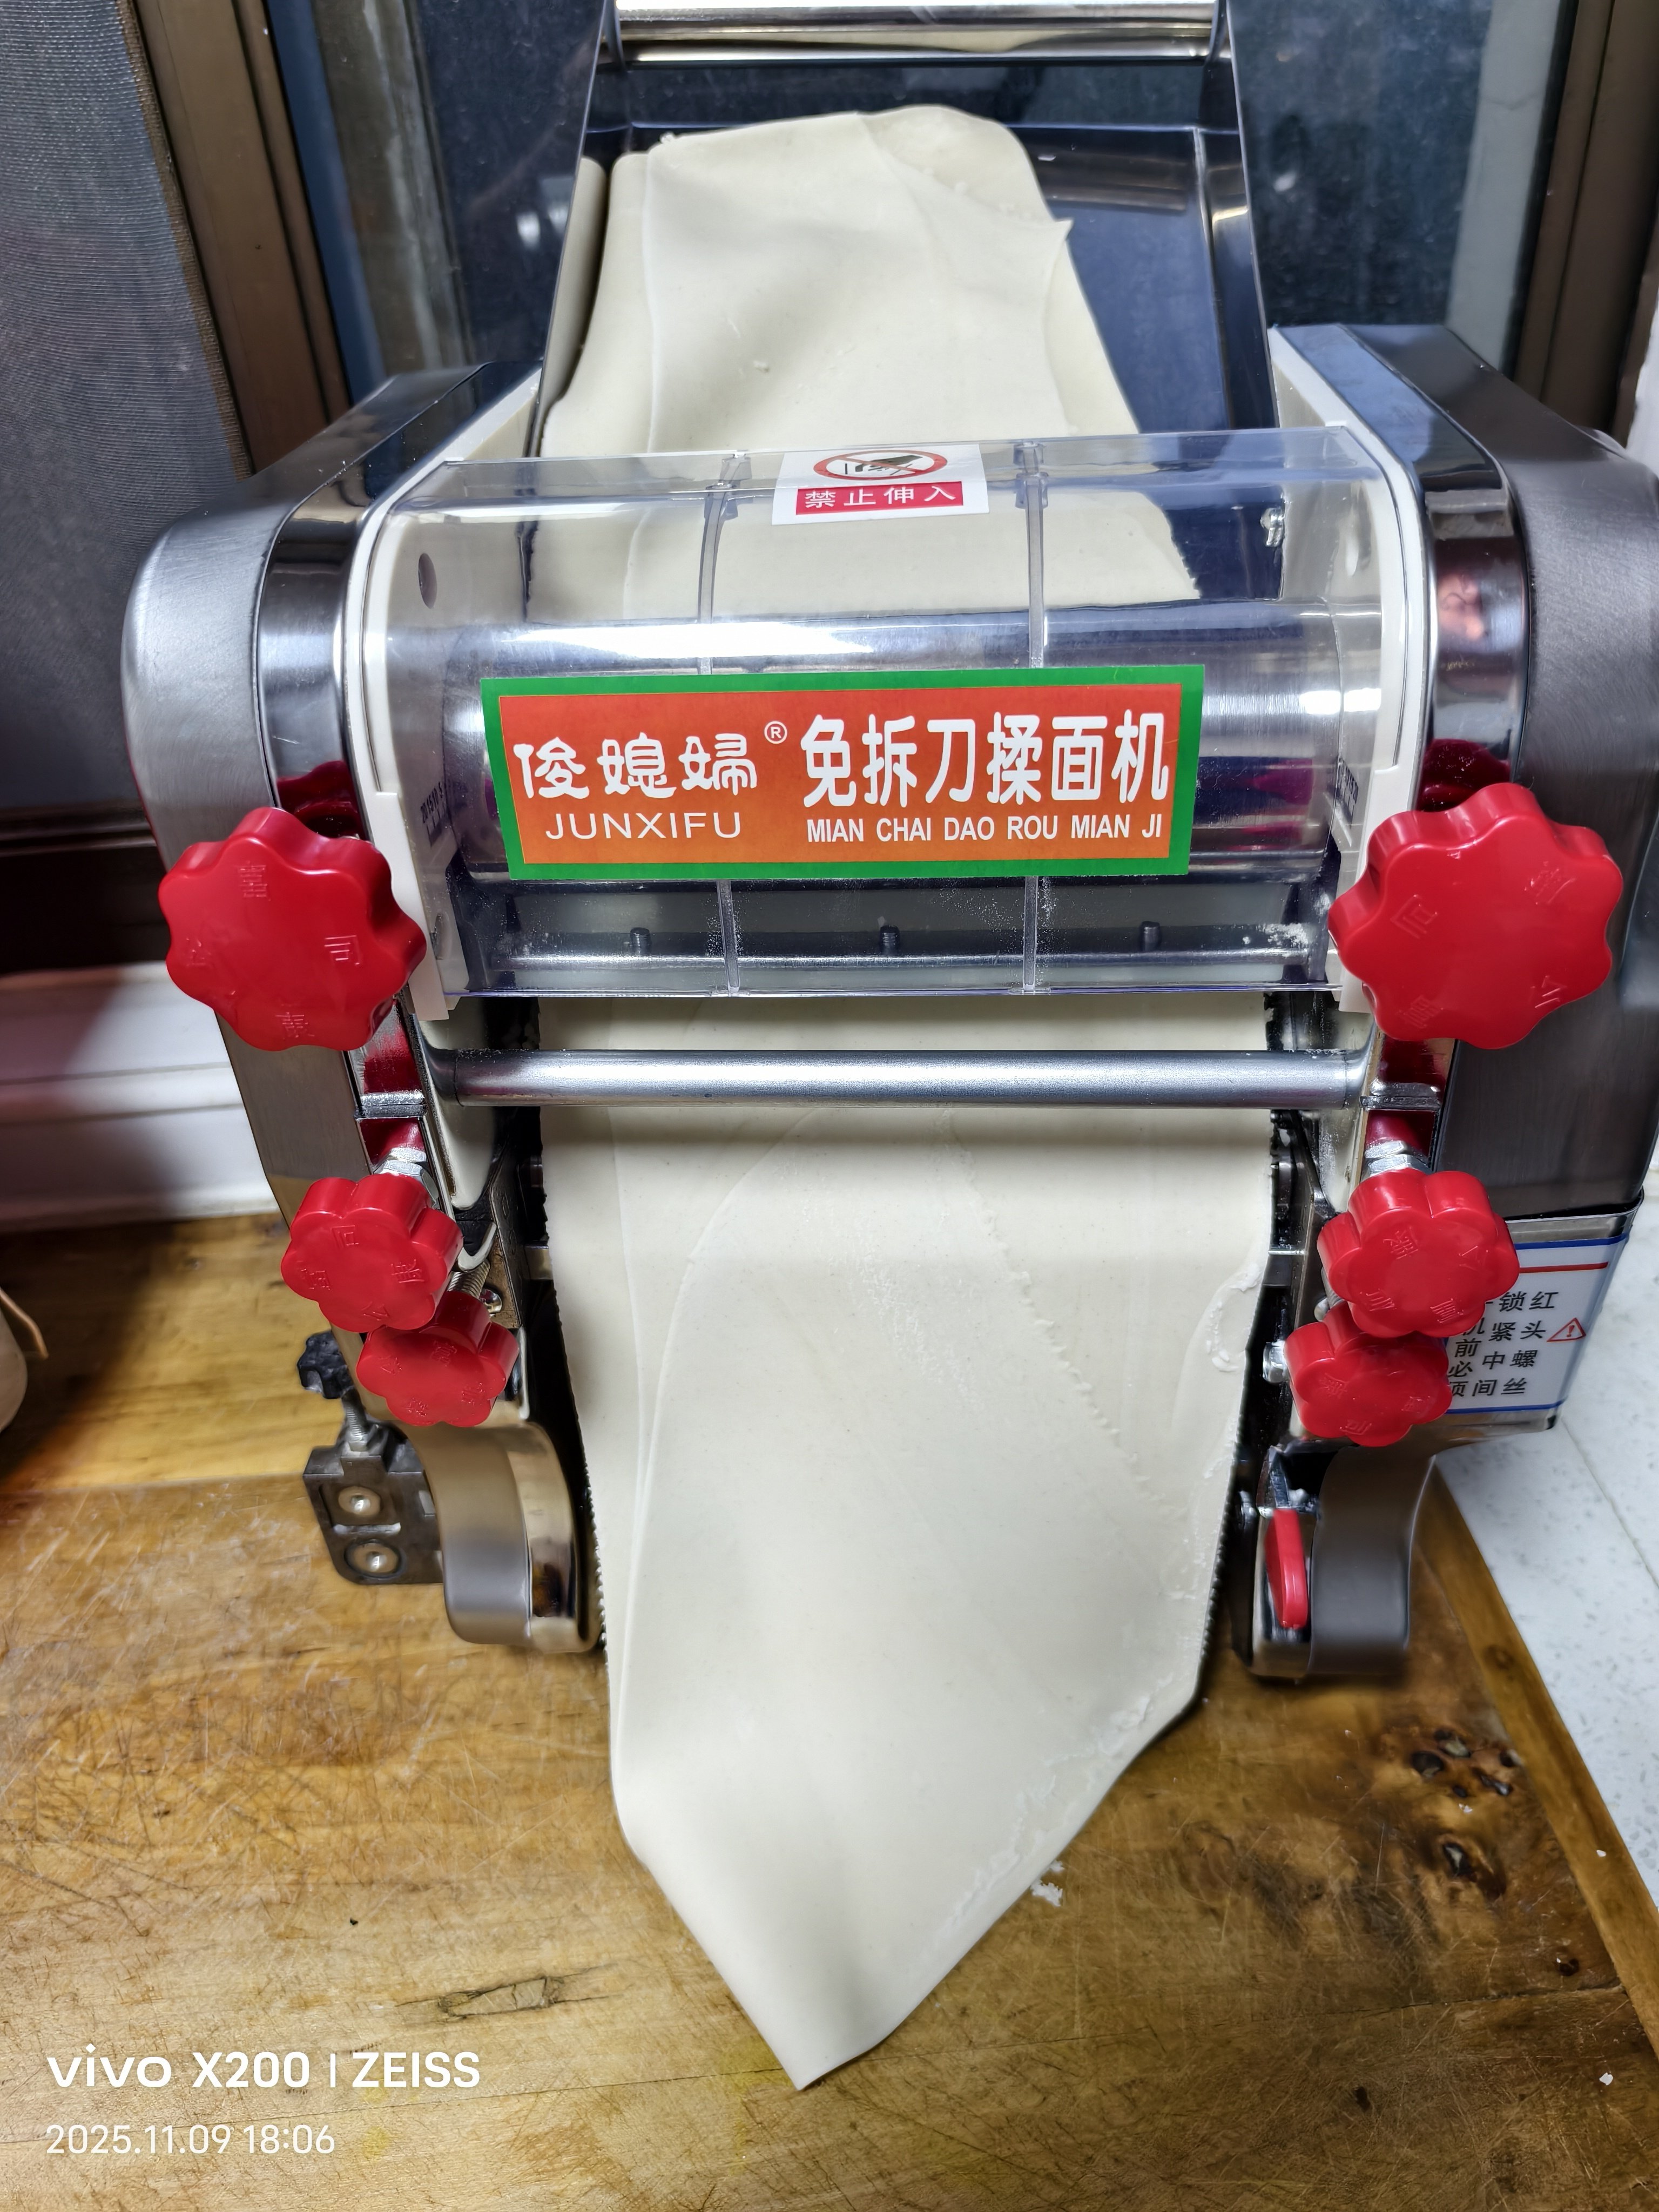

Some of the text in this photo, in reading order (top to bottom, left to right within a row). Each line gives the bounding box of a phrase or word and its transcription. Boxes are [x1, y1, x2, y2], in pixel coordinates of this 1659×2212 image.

[804, 486, 956, 509] 禁止伸入
[800, 710, 1170, 808] 免拆刀揉面机
[545, 812, 741, 840] JUNXIFU
[807, 814, 1162, 844] MIAN CHAI DAO ROU MIAN JI
